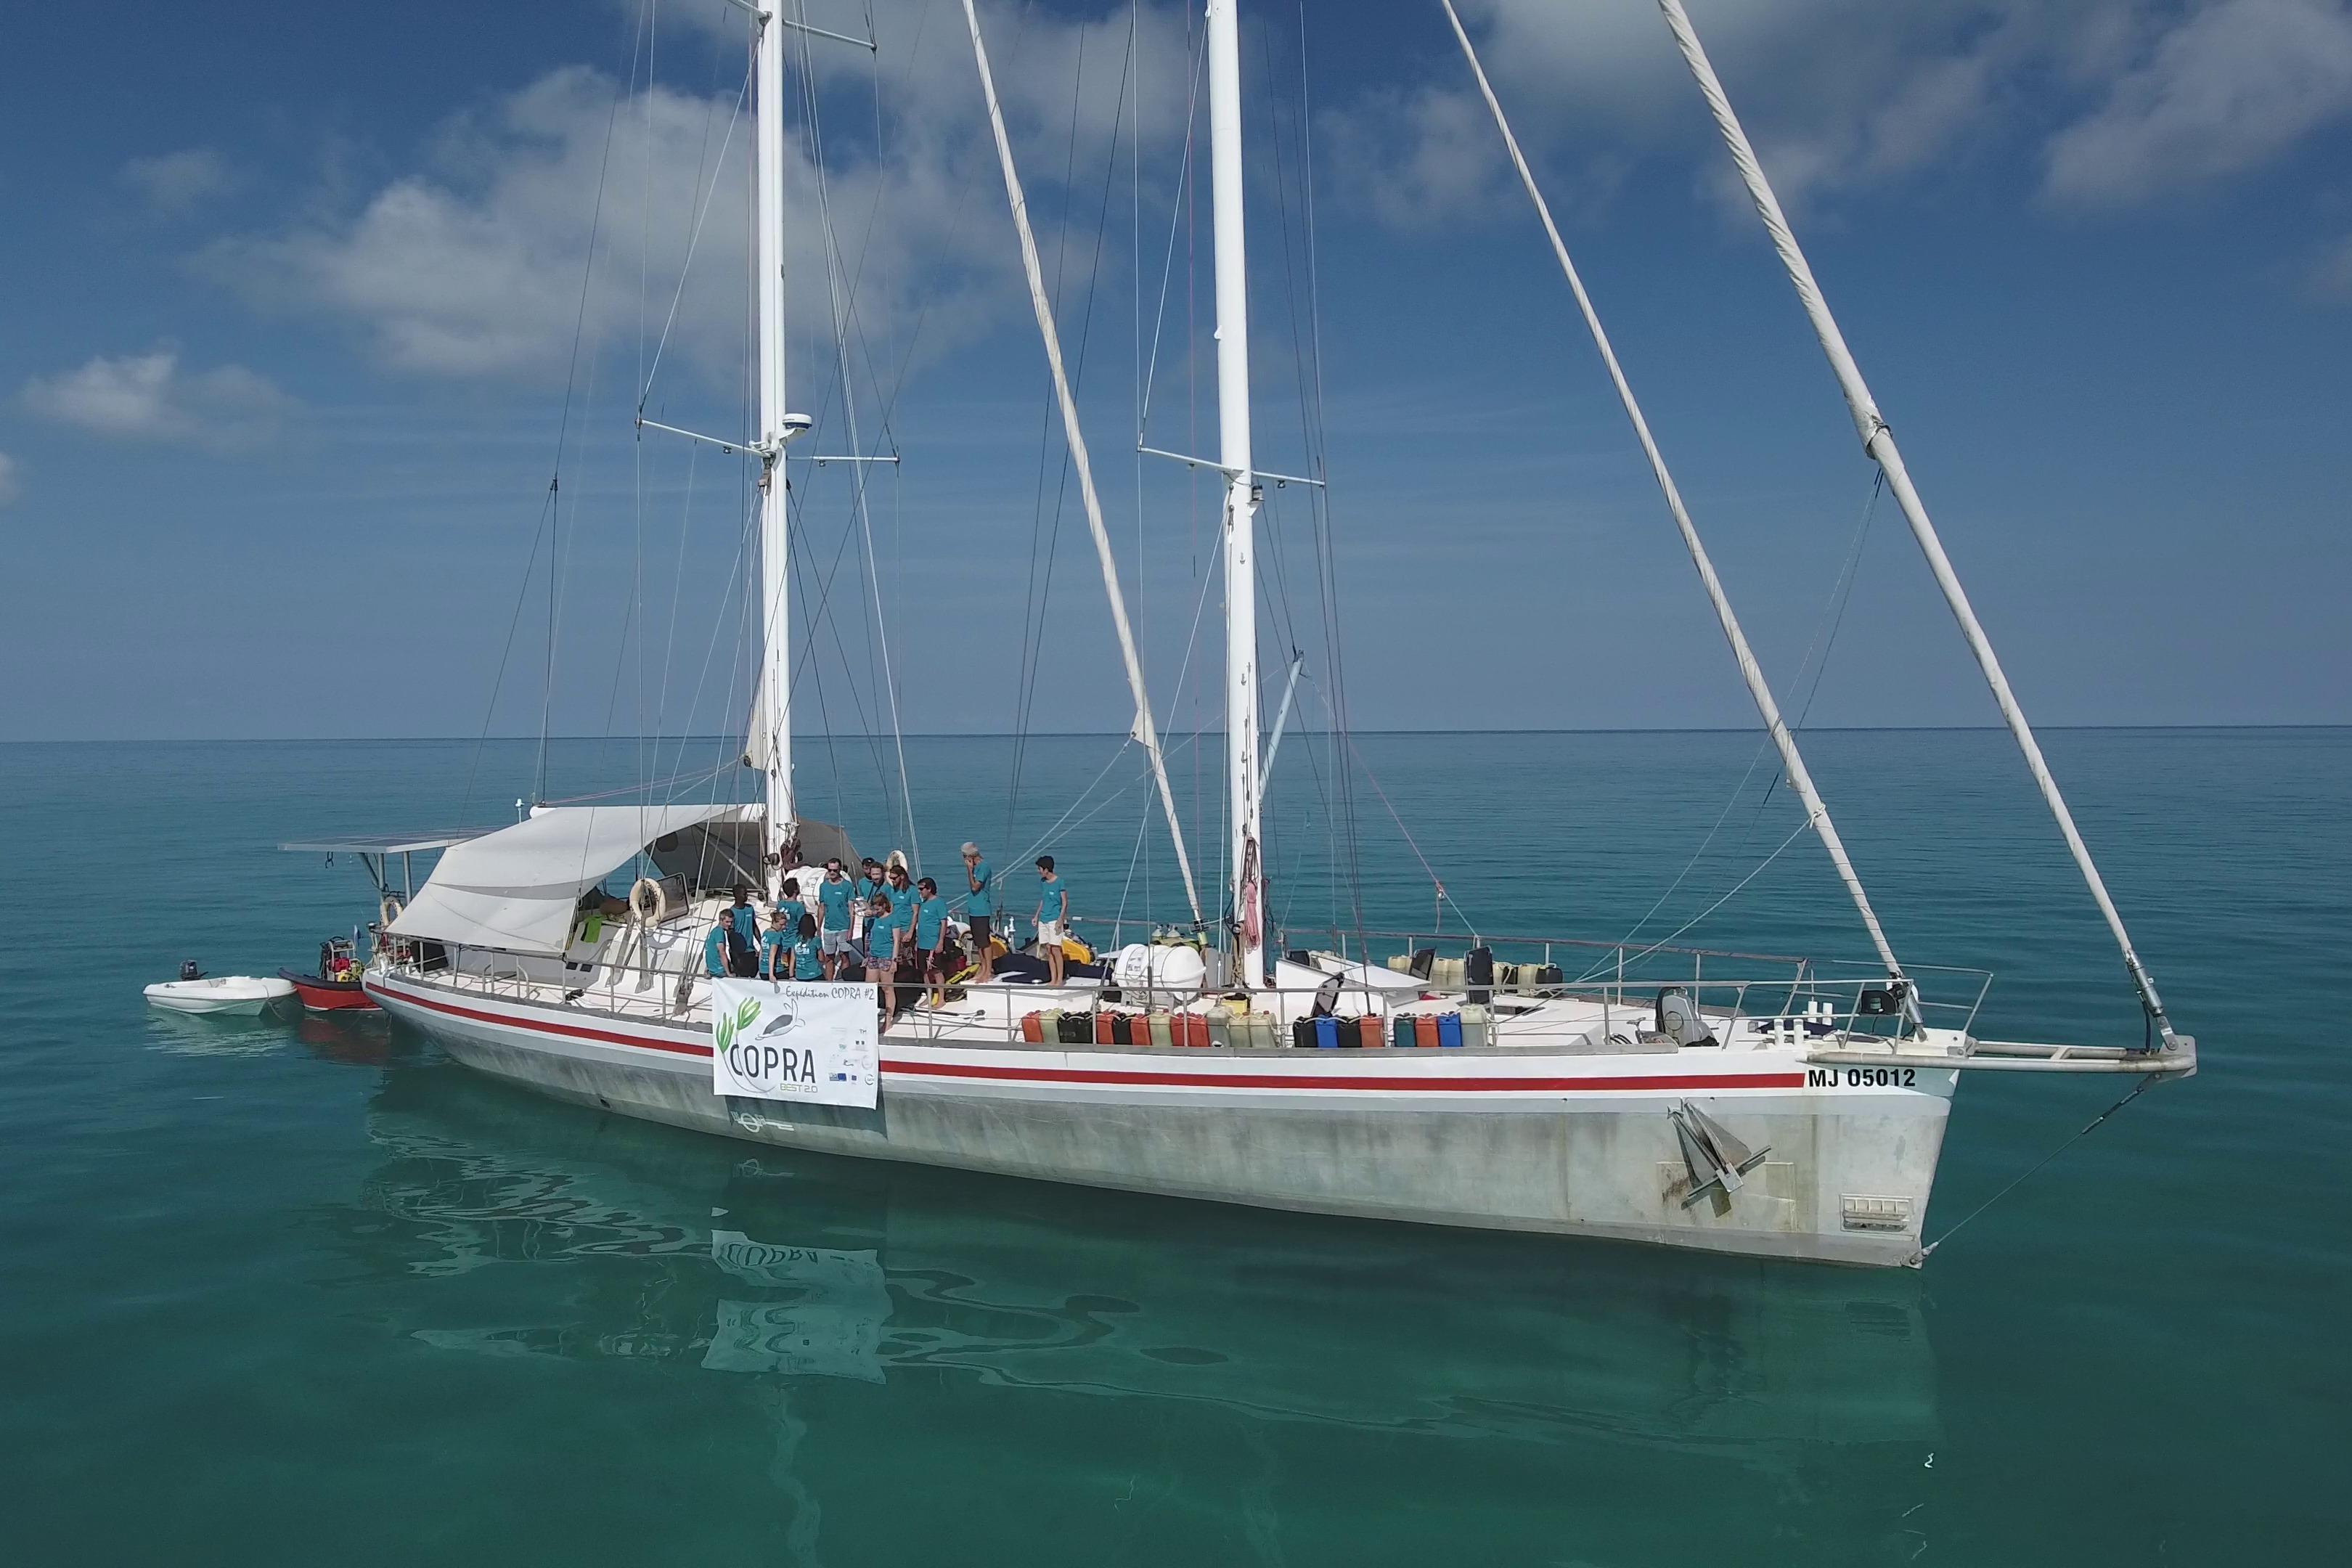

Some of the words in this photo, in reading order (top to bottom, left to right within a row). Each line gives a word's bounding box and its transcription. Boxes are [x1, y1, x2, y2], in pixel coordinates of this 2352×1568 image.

[831, 987, 861, 999] COPRA
[865, 988, 875, 1000] #2
[730, 1044, 816, 1084] COPRA
[1808, 1069, 1839, 1087] MJ
[1847, 1069, 1916, 1087] 05012
[780, 1083, 802, 1093] BEST
